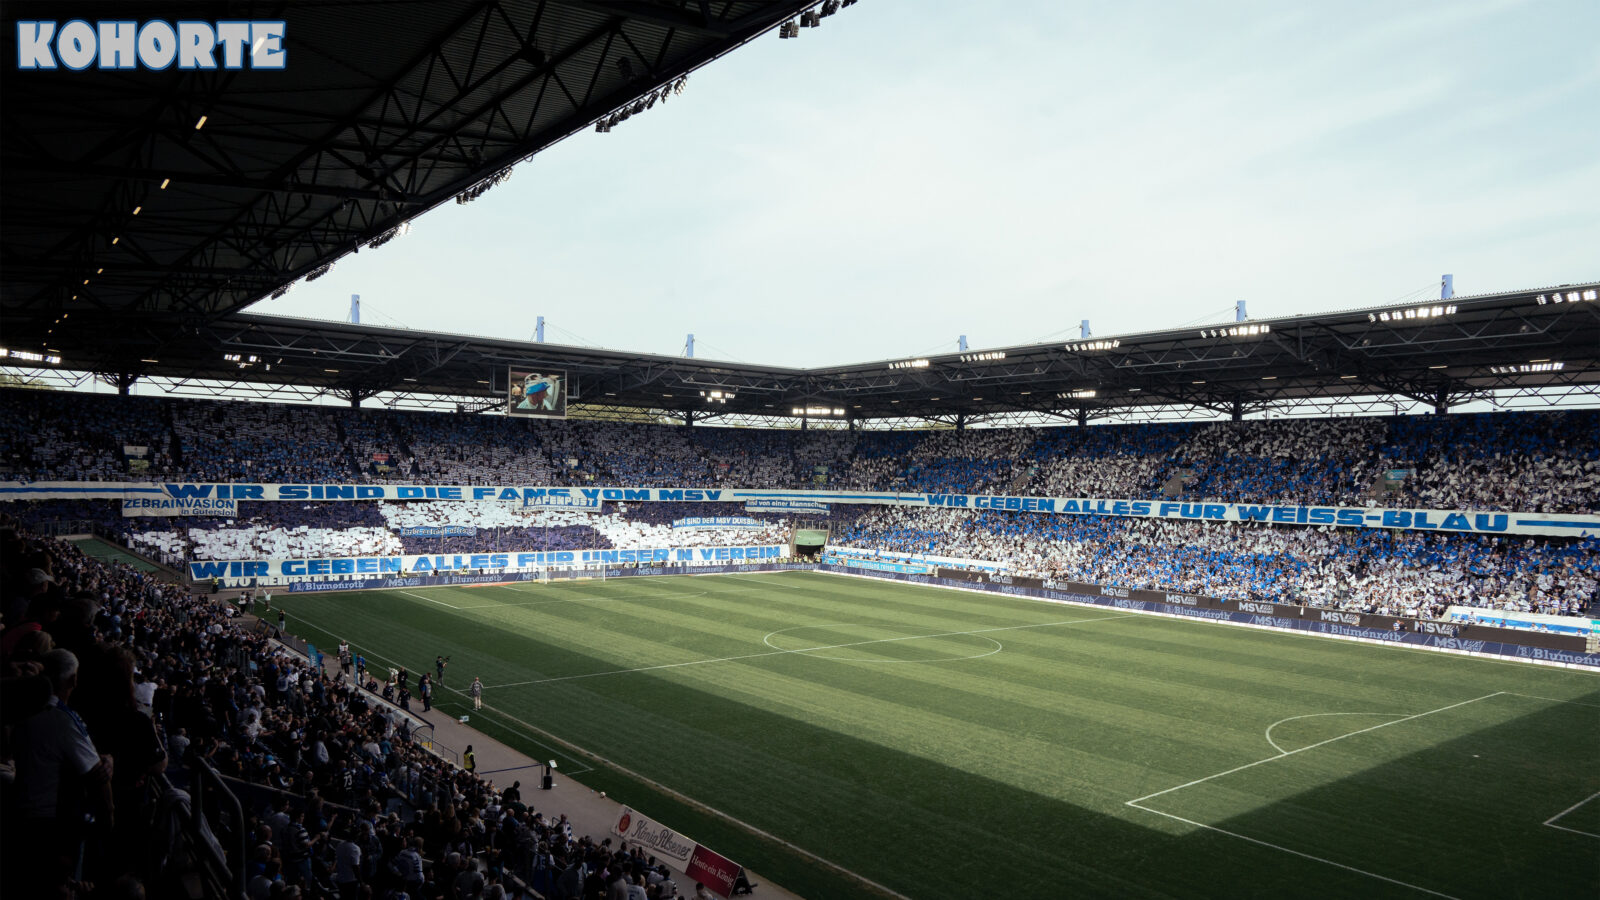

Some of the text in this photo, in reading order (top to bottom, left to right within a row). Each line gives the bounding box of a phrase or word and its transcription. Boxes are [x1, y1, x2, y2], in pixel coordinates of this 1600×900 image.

[165, 484, 264, 499] WIR
[279, 486, 384, 499] SIND
[396, 487, 462, 499] DIE
[473, 487, 571, 500] FANS
[659, 490, 722, 500] MSV
[124, 498, 234, 509] ZEBRAINVASION
[927, 494, 968, 507] WIR
[974, 497, 1055, 511] GEBEN
[1062, 500, 1151, 515] ALLES
[1237, 506, 1508, 531] WEISS-BLAU
[190, 561, 269, 578] WIR
[281, 558, 401, 576] GEBEN
[411, 554, 509, 572] ALLES
[700, 546, 780, 561] VEREIN
[305, 581, 364, 590] Blumenroth
[451, 574, 502, 583] Blumenroth
[1050, 591, 1094, 603] Blumenroth
[1175, 605, 1230, 620] Blumenroth
[1330, 624, 1401, 641] Blumenroth
[631, 820, 691, 857] König Pilsener
[691, 854, 734, 888] Heute ein König
